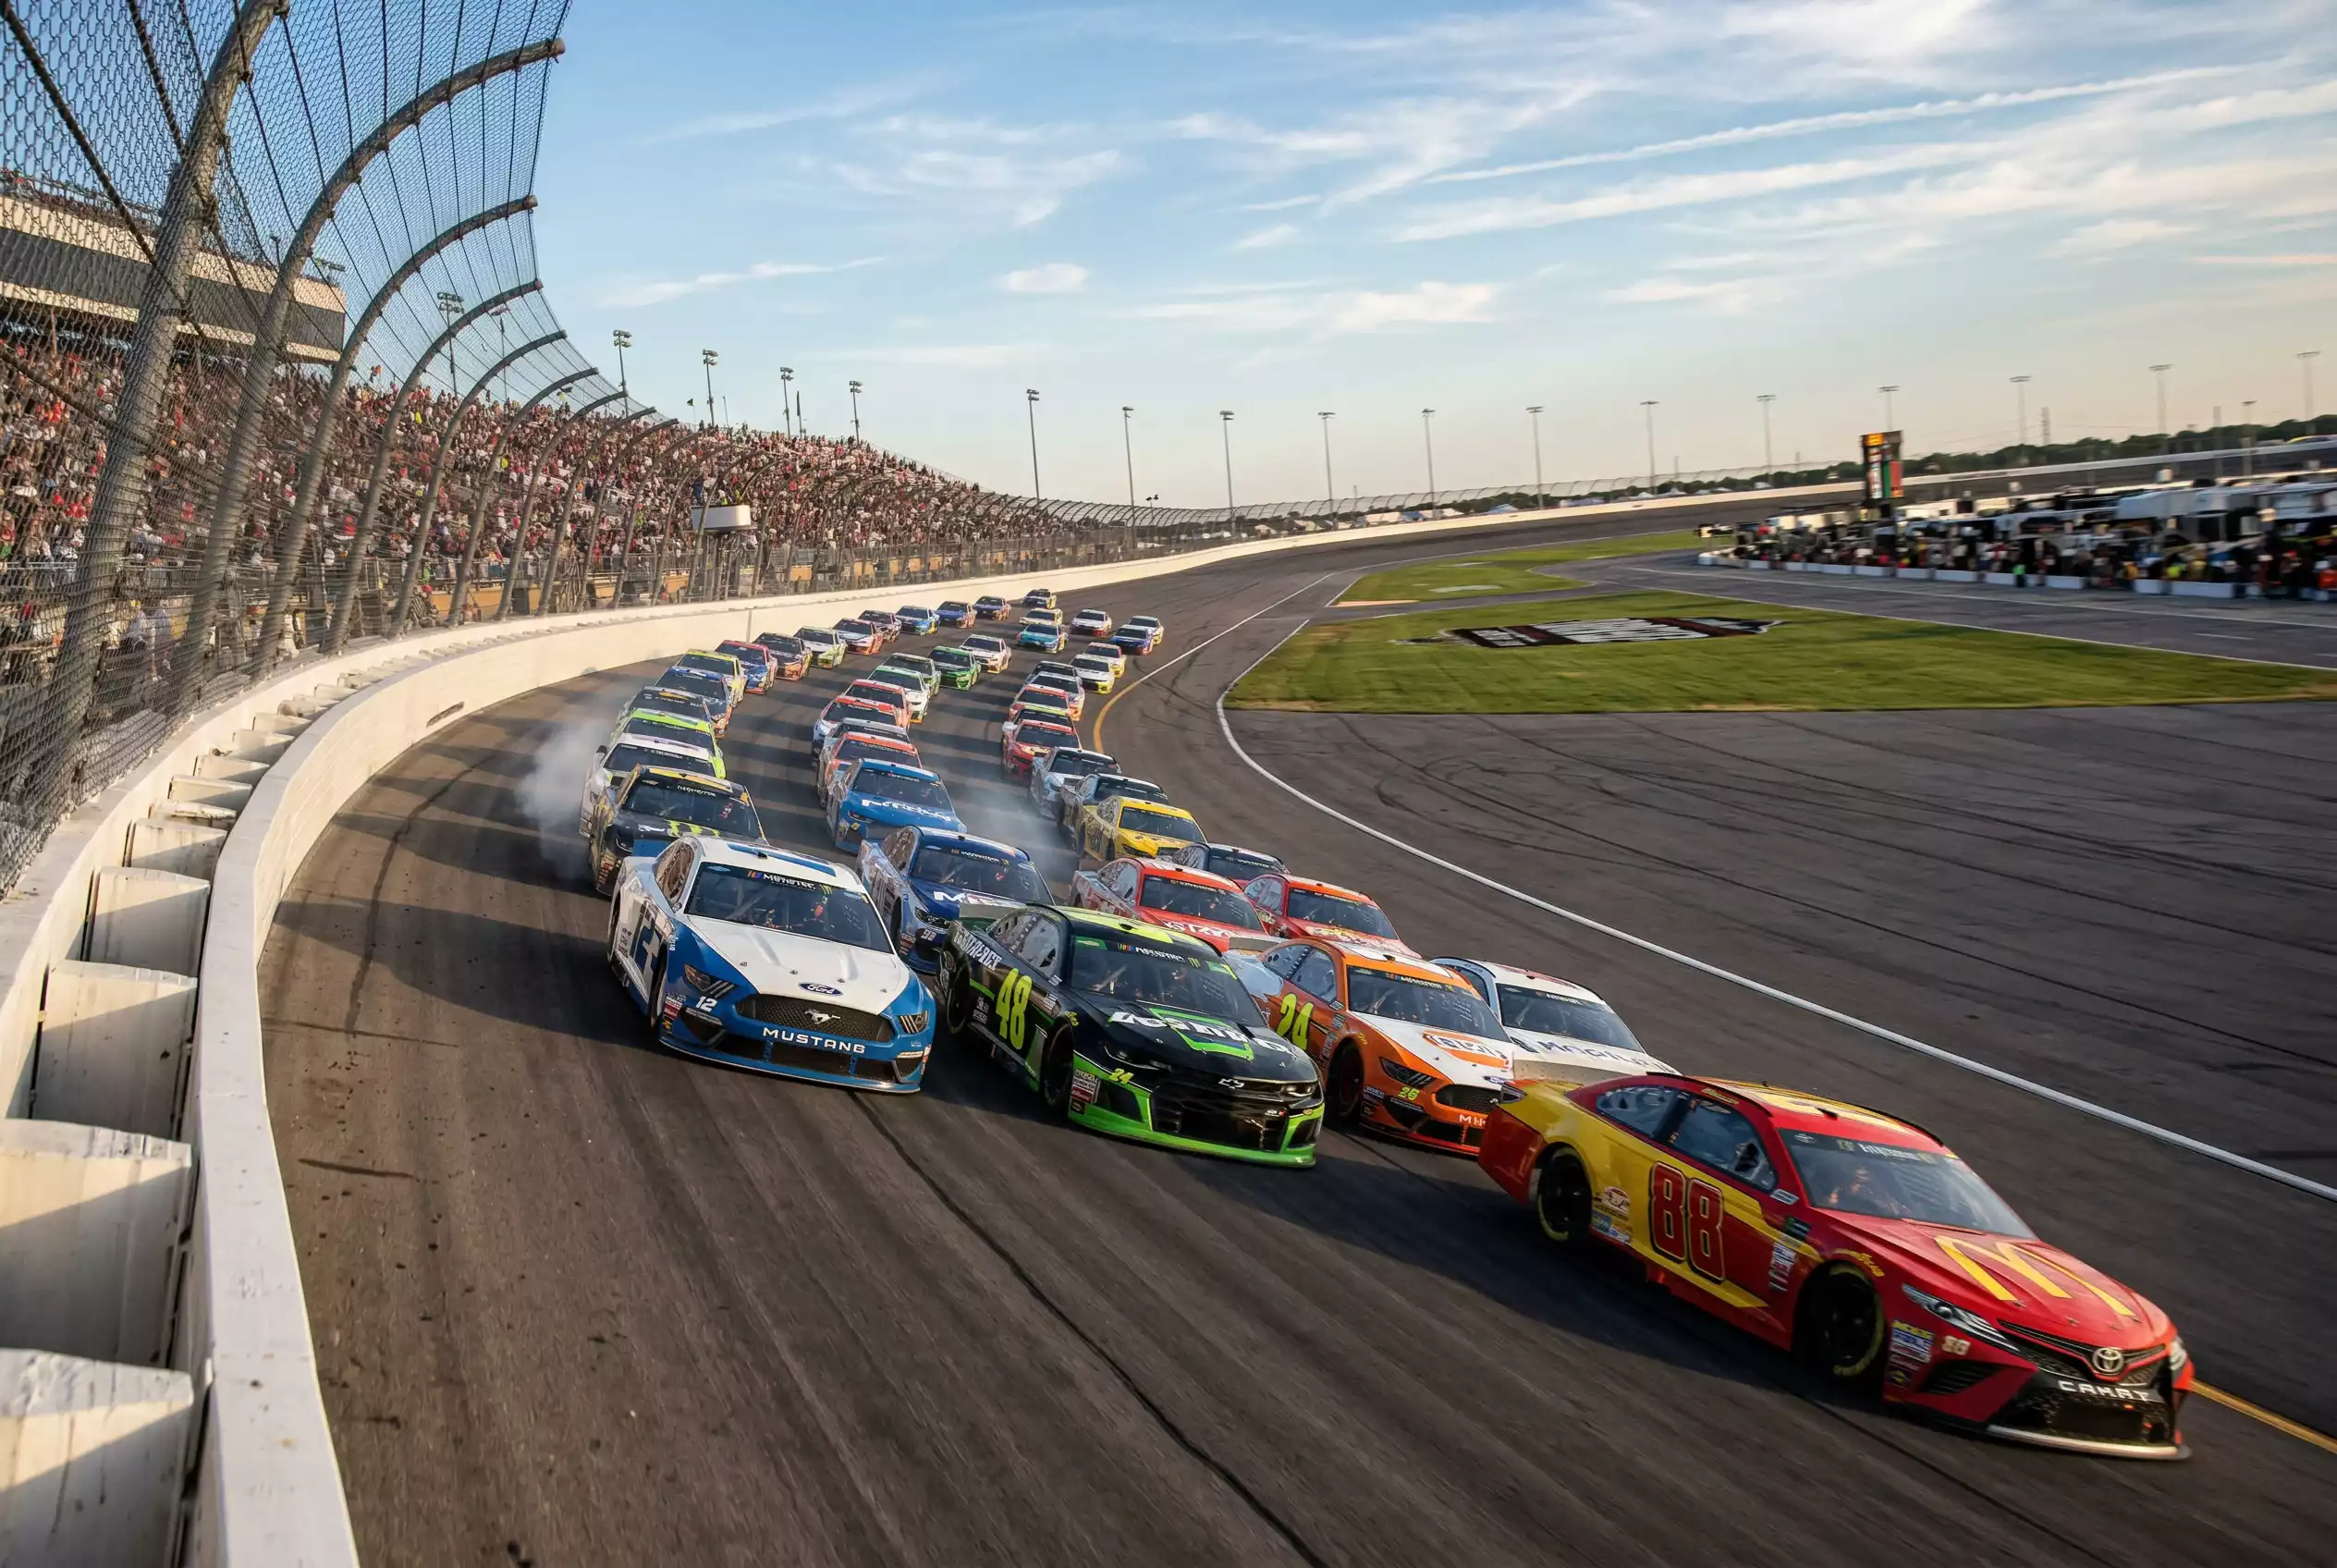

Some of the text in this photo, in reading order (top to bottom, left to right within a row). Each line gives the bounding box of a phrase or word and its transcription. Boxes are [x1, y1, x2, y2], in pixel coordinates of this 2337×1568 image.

[695, 996, 717, 1012] 12
[996, 968, 1032, 1049] 48
[1277, 993, 1314, 1050] 24
[763, 1027, 866, 1054] MUSTANG
[1109, 1068, 1134, 1084] 24
[1648, 1163, 1725, 1282] 88
